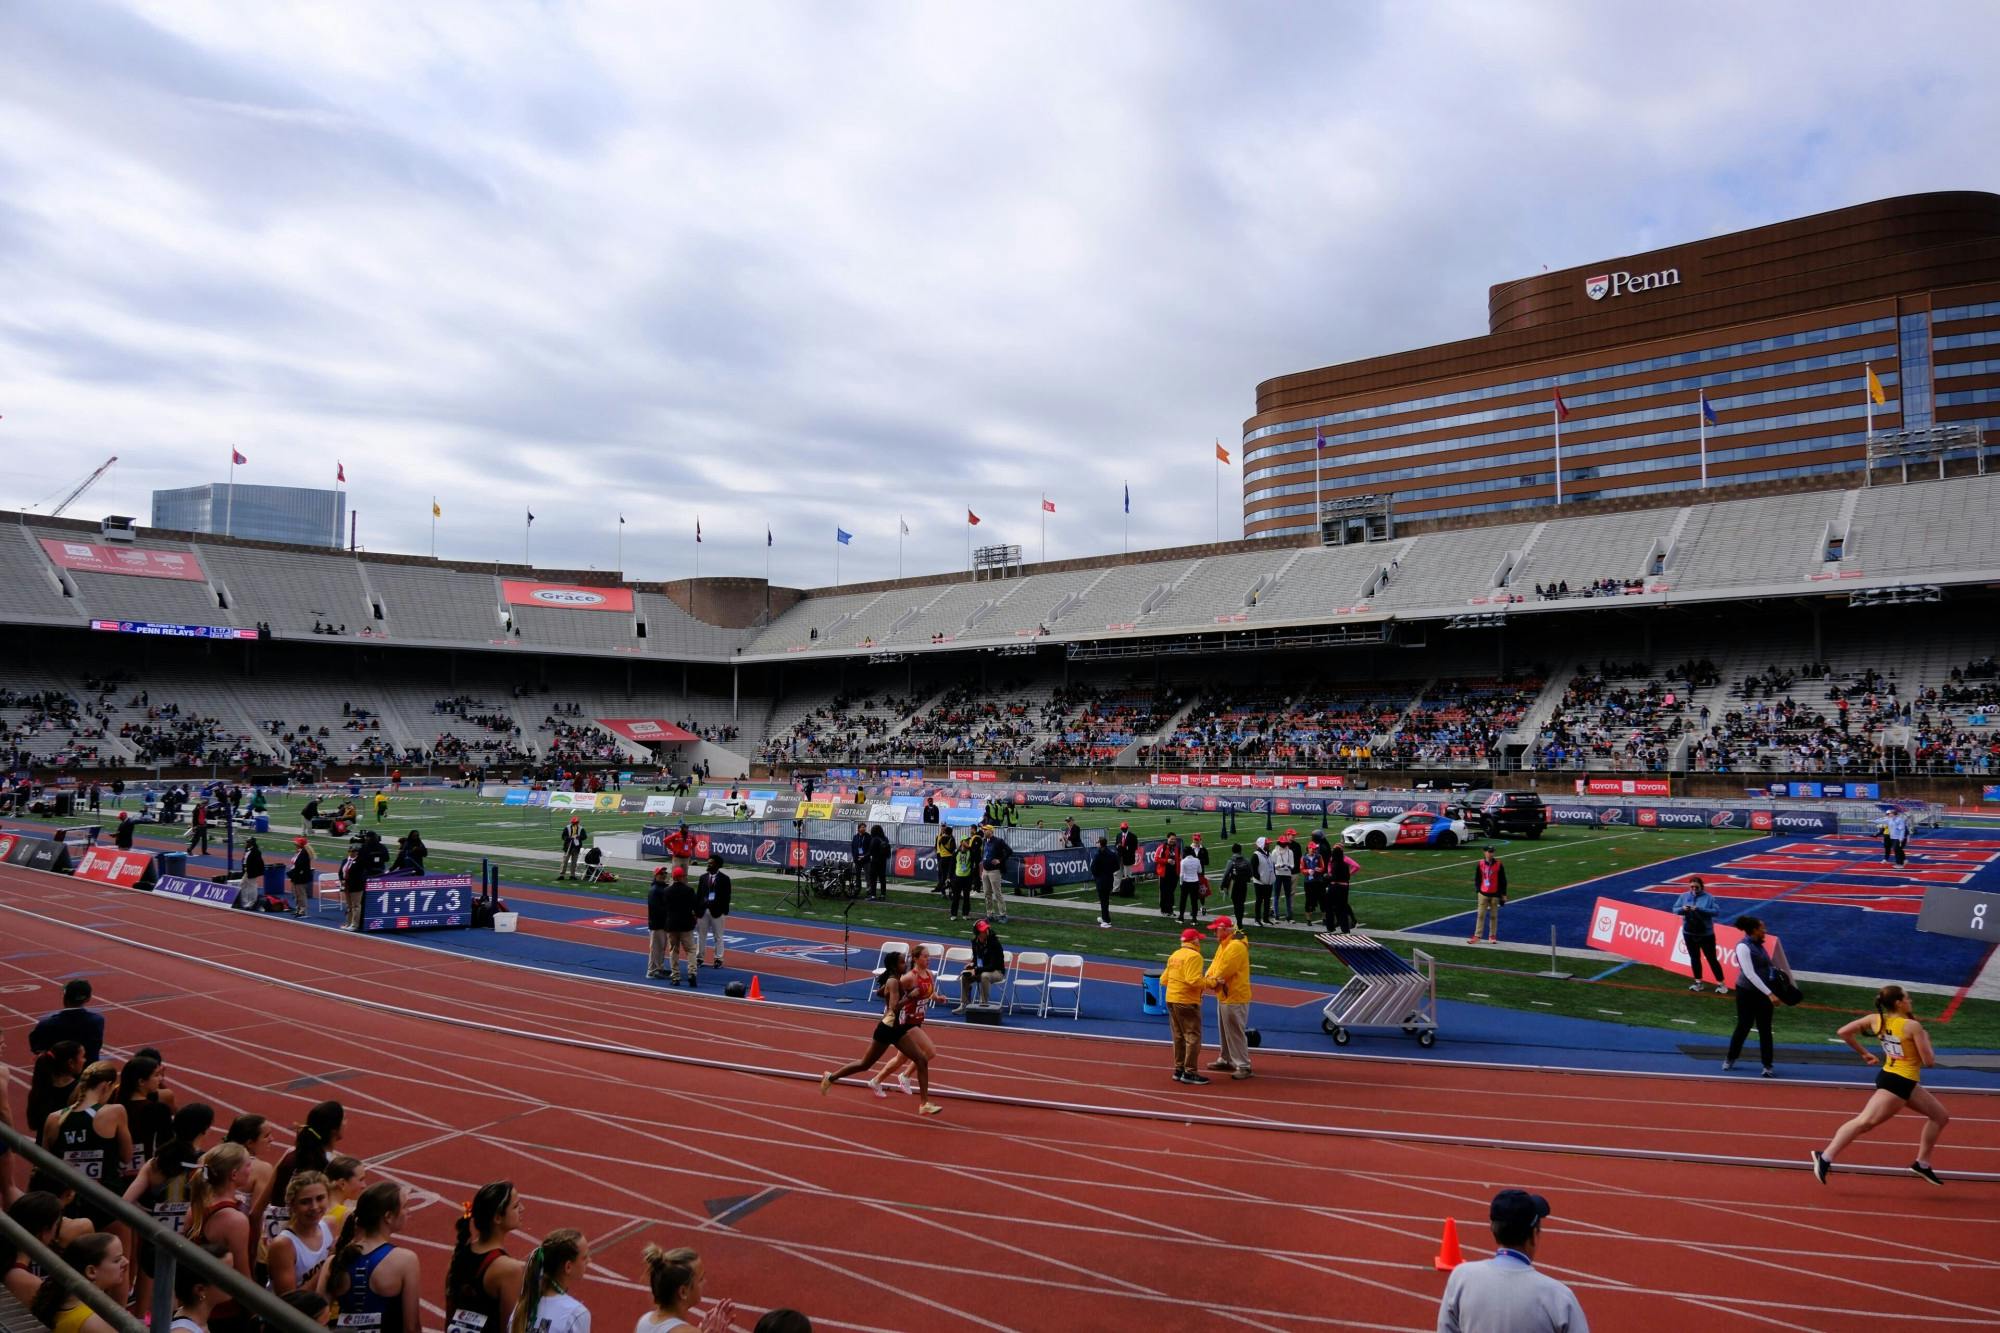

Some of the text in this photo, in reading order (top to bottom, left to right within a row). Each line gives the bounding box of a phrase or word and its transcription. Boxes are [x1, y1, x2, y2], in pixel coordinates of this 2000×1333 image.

[1611, 268, 1681, 297] Penn
[541, 592, 595, 602] Grace
[137, 627, 194, 637] PENN RELAYS
[1027, 794, 1049, 802] TOYOTA
[1150, 798, 1175, 806] TOYOTA
[838, 808, 867, 816] FLOTRACK
[1291, 802, 1321, 811] TOYOTA
[1371, 805, 1404, 814] TOYOTA
[1554, 810, 1593, 820] TOYOTA
[1659, 814, 1703, 823] TOYOTA
[1774, 817, 1823, 828] TOYOTA
[712, 842, 748, 856] TOYOTA
[810, 849, 848, 862] TOYOTA
[91, 859, 111, 871] TOYOTA
[122, 864, 143, 876] TOYOTA
[1049, 860, 1089, 875] TOYOTA
[164, 878, 187, 893] LYNX
[438, 878, 471, 886] SCHOOLS
[204, 884, 229, 901] LYNX
[377, 889, 461, 914] 1:17.3
[1618, 921, 1665, 947] TOYOTA
